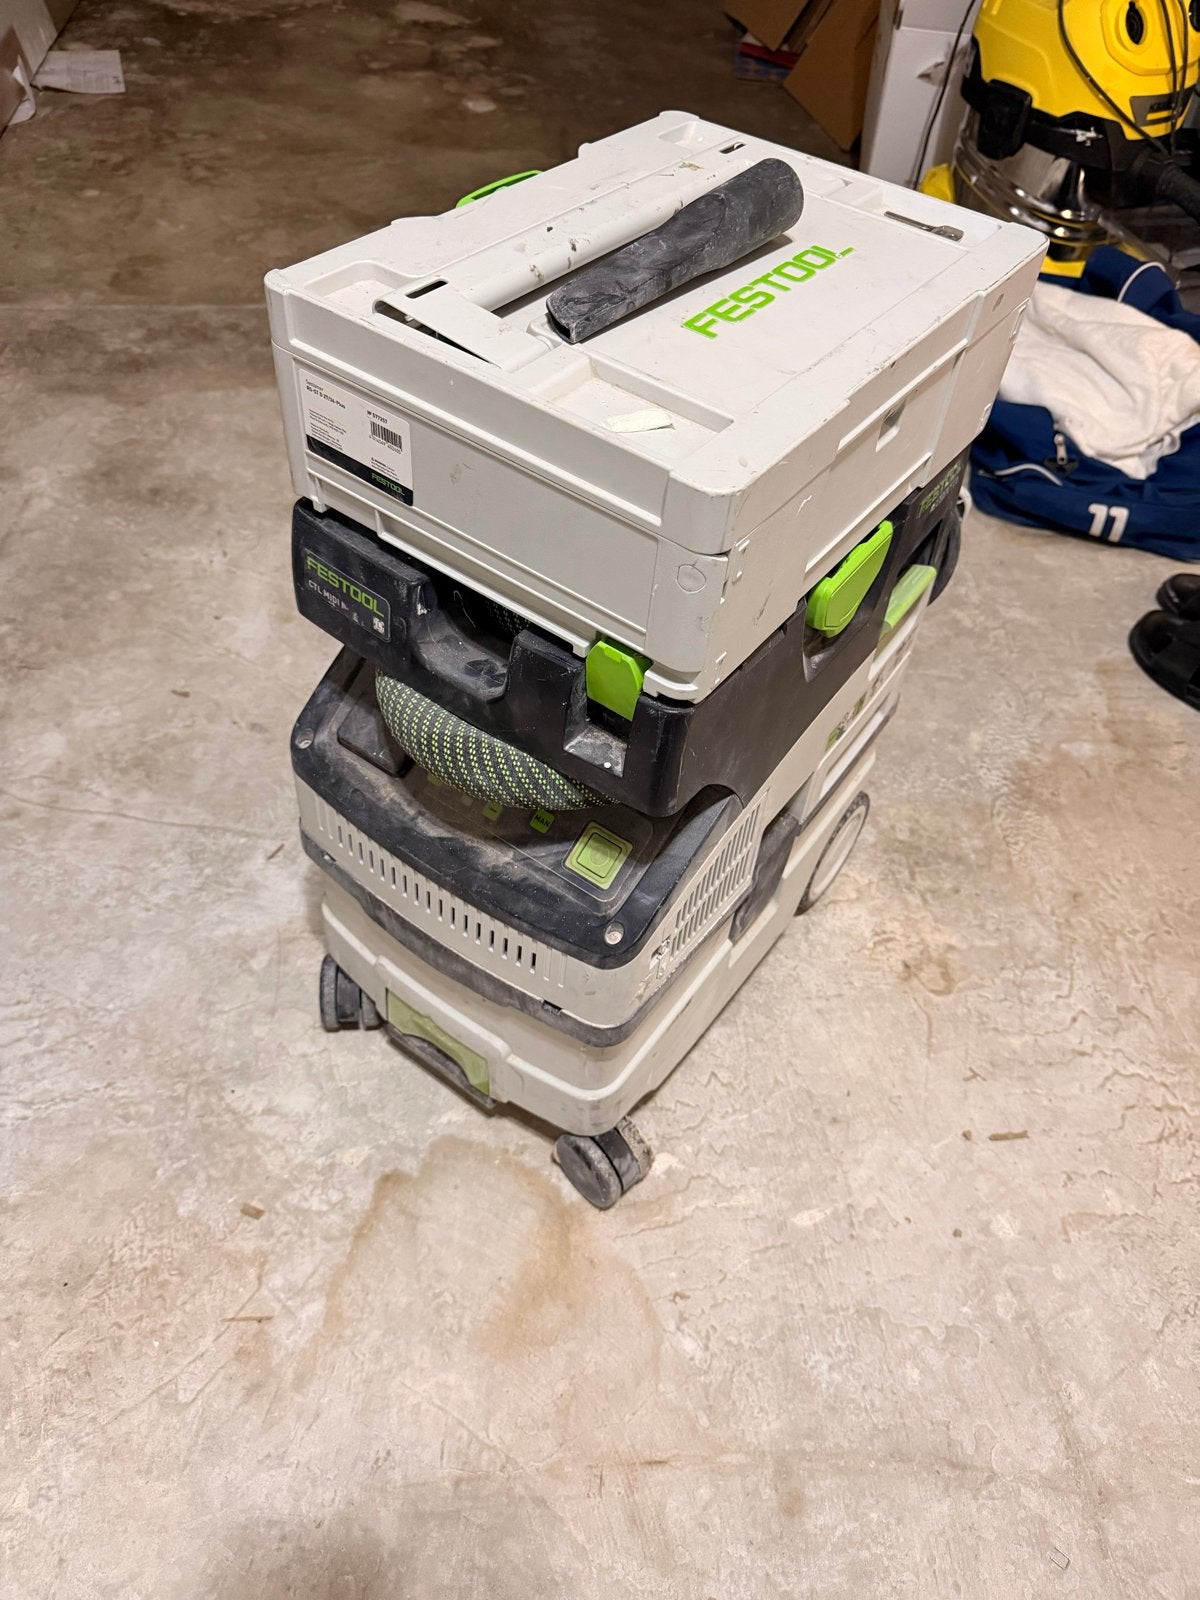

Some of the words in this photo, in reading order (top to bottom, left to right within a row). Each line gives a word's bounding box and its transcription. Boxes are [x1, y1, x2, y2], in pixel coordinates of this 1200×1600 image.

[682, 244, 856, 339] FESTOOL
[371, 472, 405, 496] FESTOOL
[1087, 503, 1129, 543] 11
[306, 556, 385, 618] FESTOOL
[323, 589, 339, 606] MIDI
[534, 814, 551, 828] MAN
